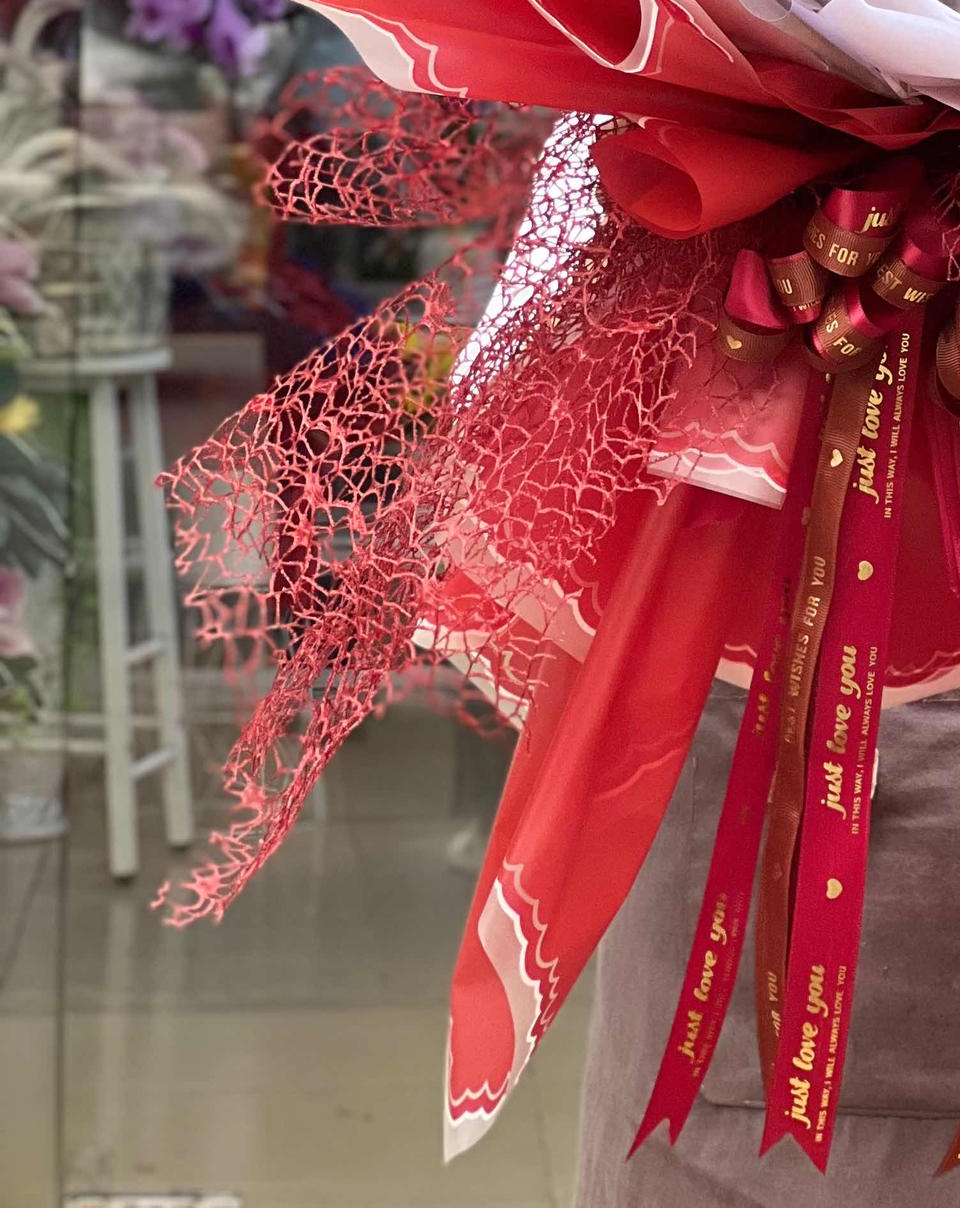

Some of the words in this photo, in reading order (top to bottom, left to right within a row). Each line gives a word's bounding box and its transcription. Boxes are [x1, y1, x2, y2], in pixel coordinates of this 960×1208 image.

[829, 243, 859, 266] FOR
[900, 333, 910, 353] YOU
[898, 357, 908, 382] LOVE
[861, 389, 883, 440] love
[893, 384, 905, 421] ALWAYS
[891, 424, 900, 448] WILL
[853, 445, 880, 505] just
[887, 455, 898, 479] WAY,
[885, 482, 894, 504] THIS
[884, 507, 892, 519] IN
[811, 556, 826, 586] YOU
[803, 595, 821, 626] FOR
[789, 635, 809, 696] WISHES
[869, 646, 878, 667] YOU
[840, 645, 862, 700] you
[866, 671, 876, 696] LOVE
[826, 703, 851, 755] love
[861, 698, 872, 736] ALWAYS
[857, 739, 867, 761] WILL
[820, 760, 846, 821] just
[854, 769, 865, 794] WAY,
[852, 796, 862, 821] THIS
[852, 823, 859, 834] IN
[767, 971, 778, 1002] YOU
[837, 965, 847, 986] YOU
[806, 964, 829, 1018] you
[834, 991, 844, 1015] LOVE
[677, 1010, 704, 1062] just
[693, 950, 718, 1002] love
[792, 1022, 819, 1071] love
[829, 1017, 840, 1054] ALWAYS
[825, 1058, 835, 1080] WILL
[784, 1076, 811, 1130] just
